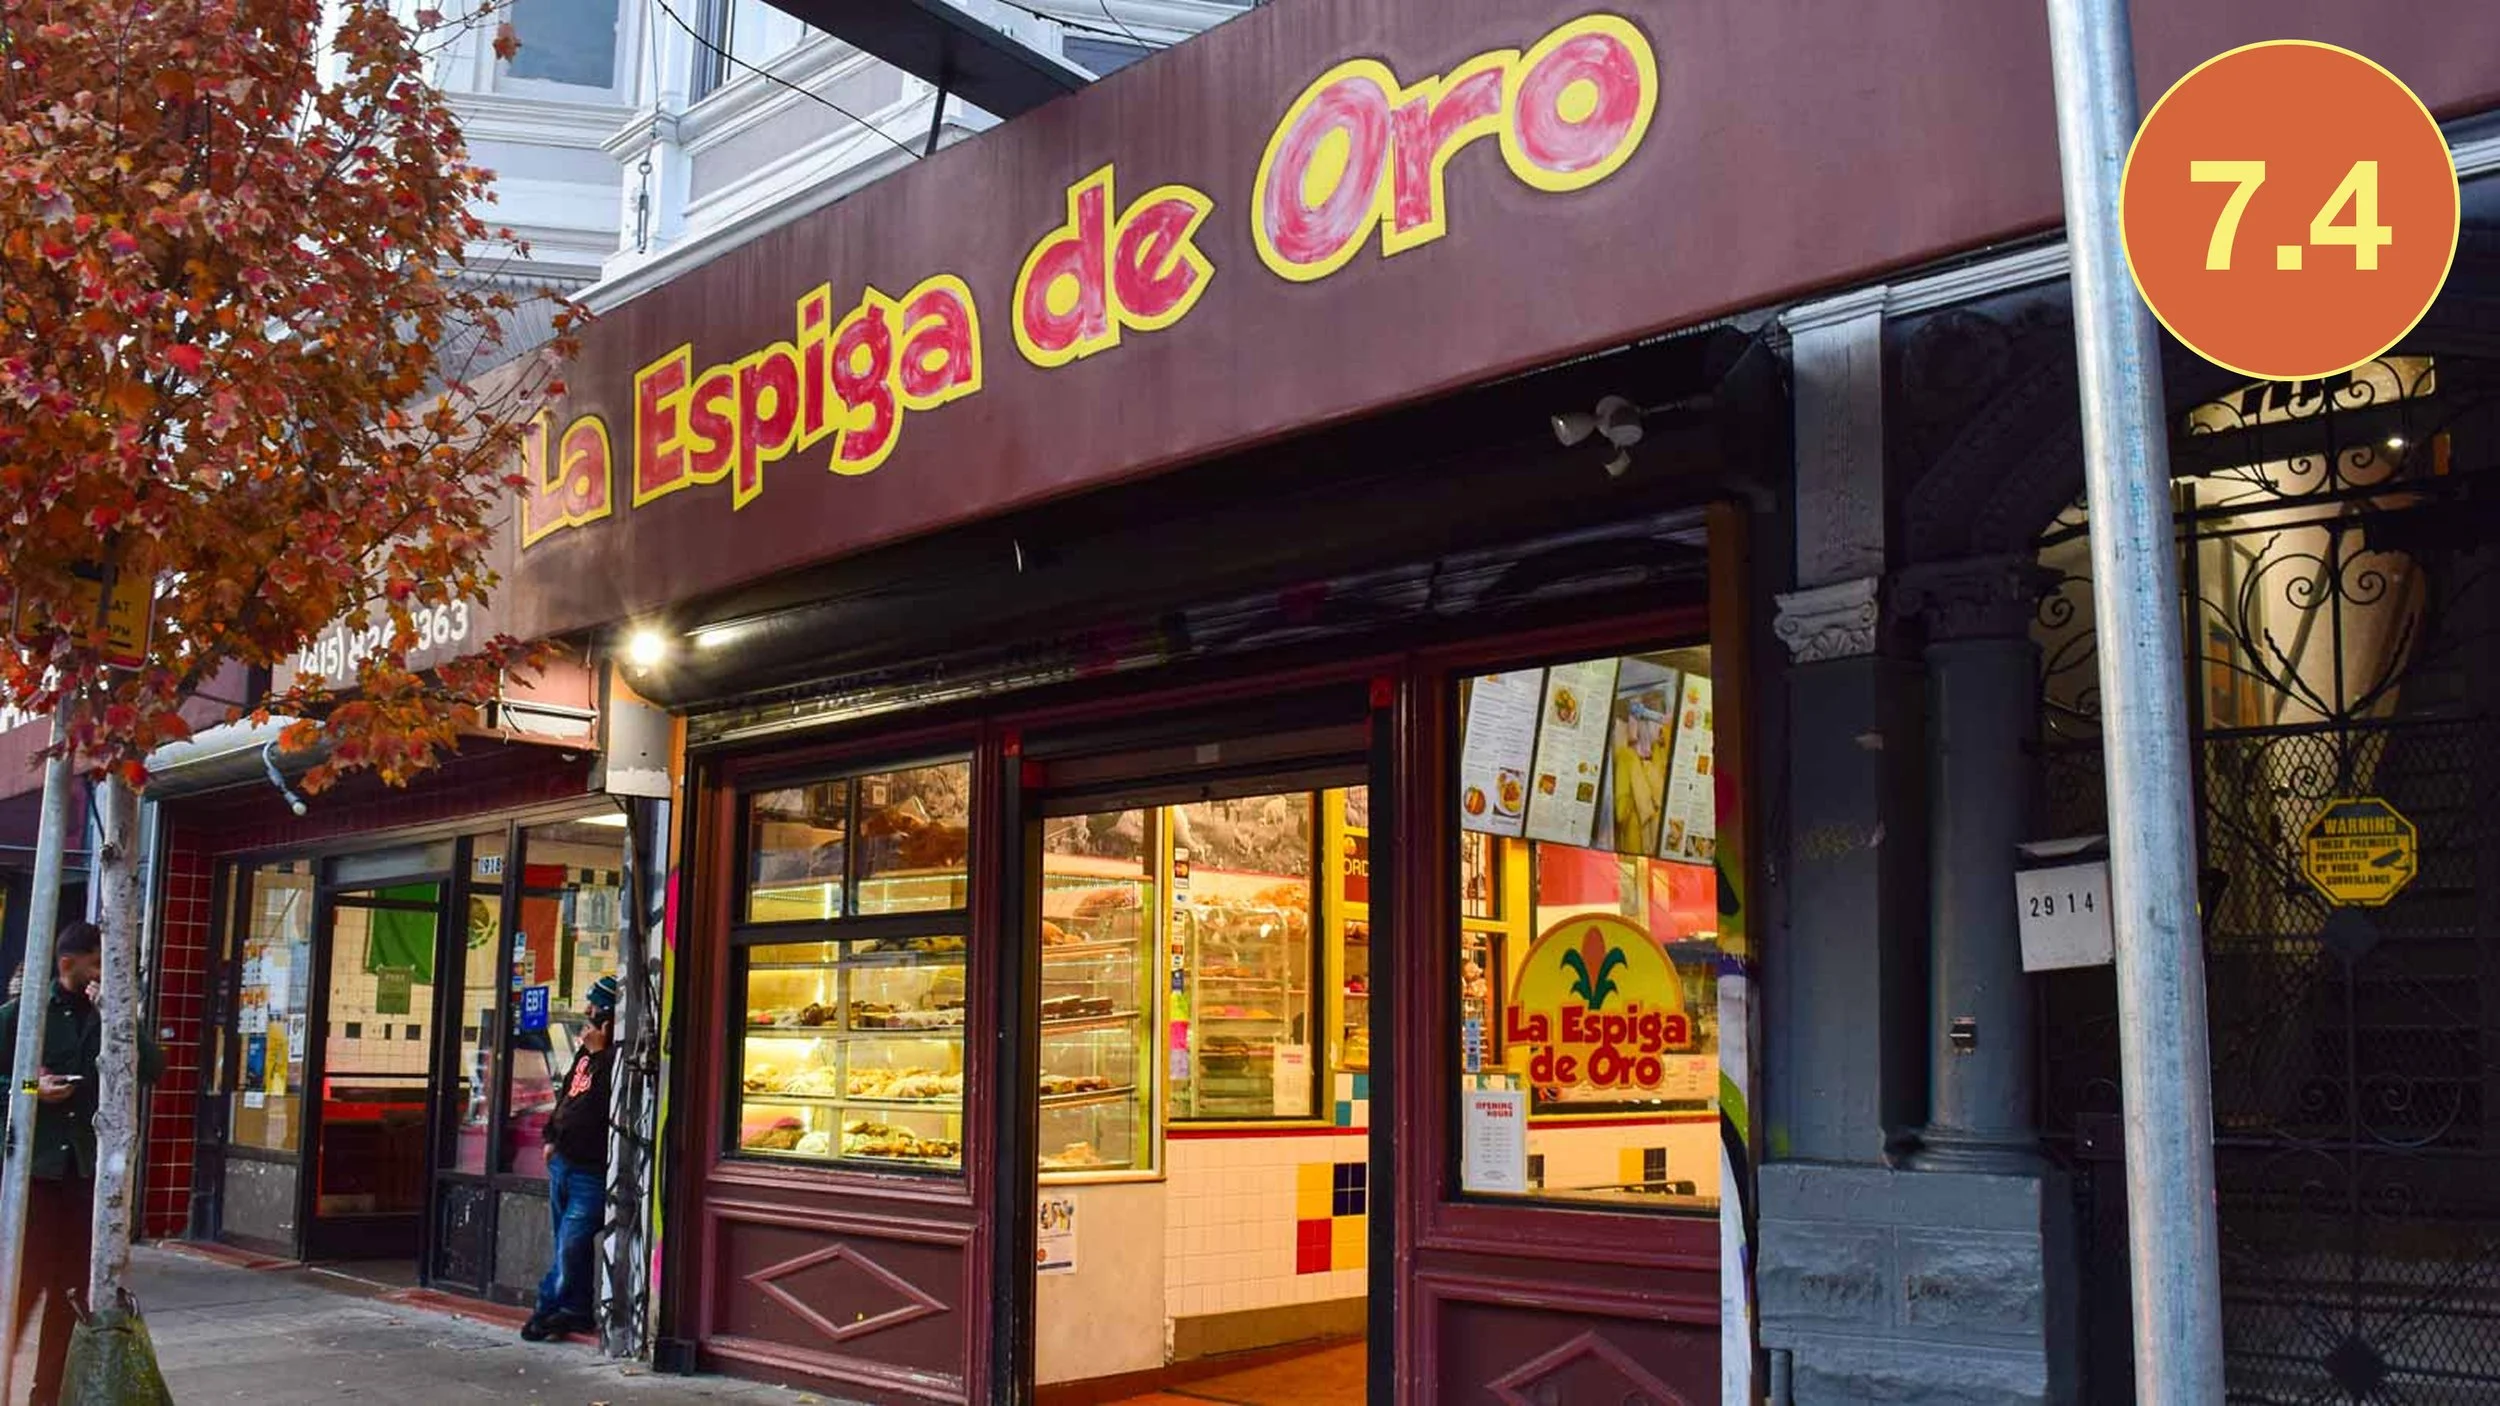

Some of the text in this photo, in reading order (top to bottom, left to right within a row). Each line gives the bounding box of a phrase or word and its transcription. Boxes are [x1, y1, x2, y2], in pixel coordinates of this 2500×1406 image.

[522, 13, 1658, 549] La Espiga de Oro
[2324, 817, 2397, 834] WARNING
[2316, 837, 2400, 849] THESE PREMISES
[2316, 851, 2369, 861] PROTECTED
[2325, 874, 2391, 885] SURVEILLANCE
[525, 987, 545, 1012] EBT
[1507, 1004, 1687, 1053] La Espiga
[1529, 1045, 1578, 1084] de
[1588, 1046, 1662, 1086] Oro
[1475, 1102, 1513, 1110] OPENING
